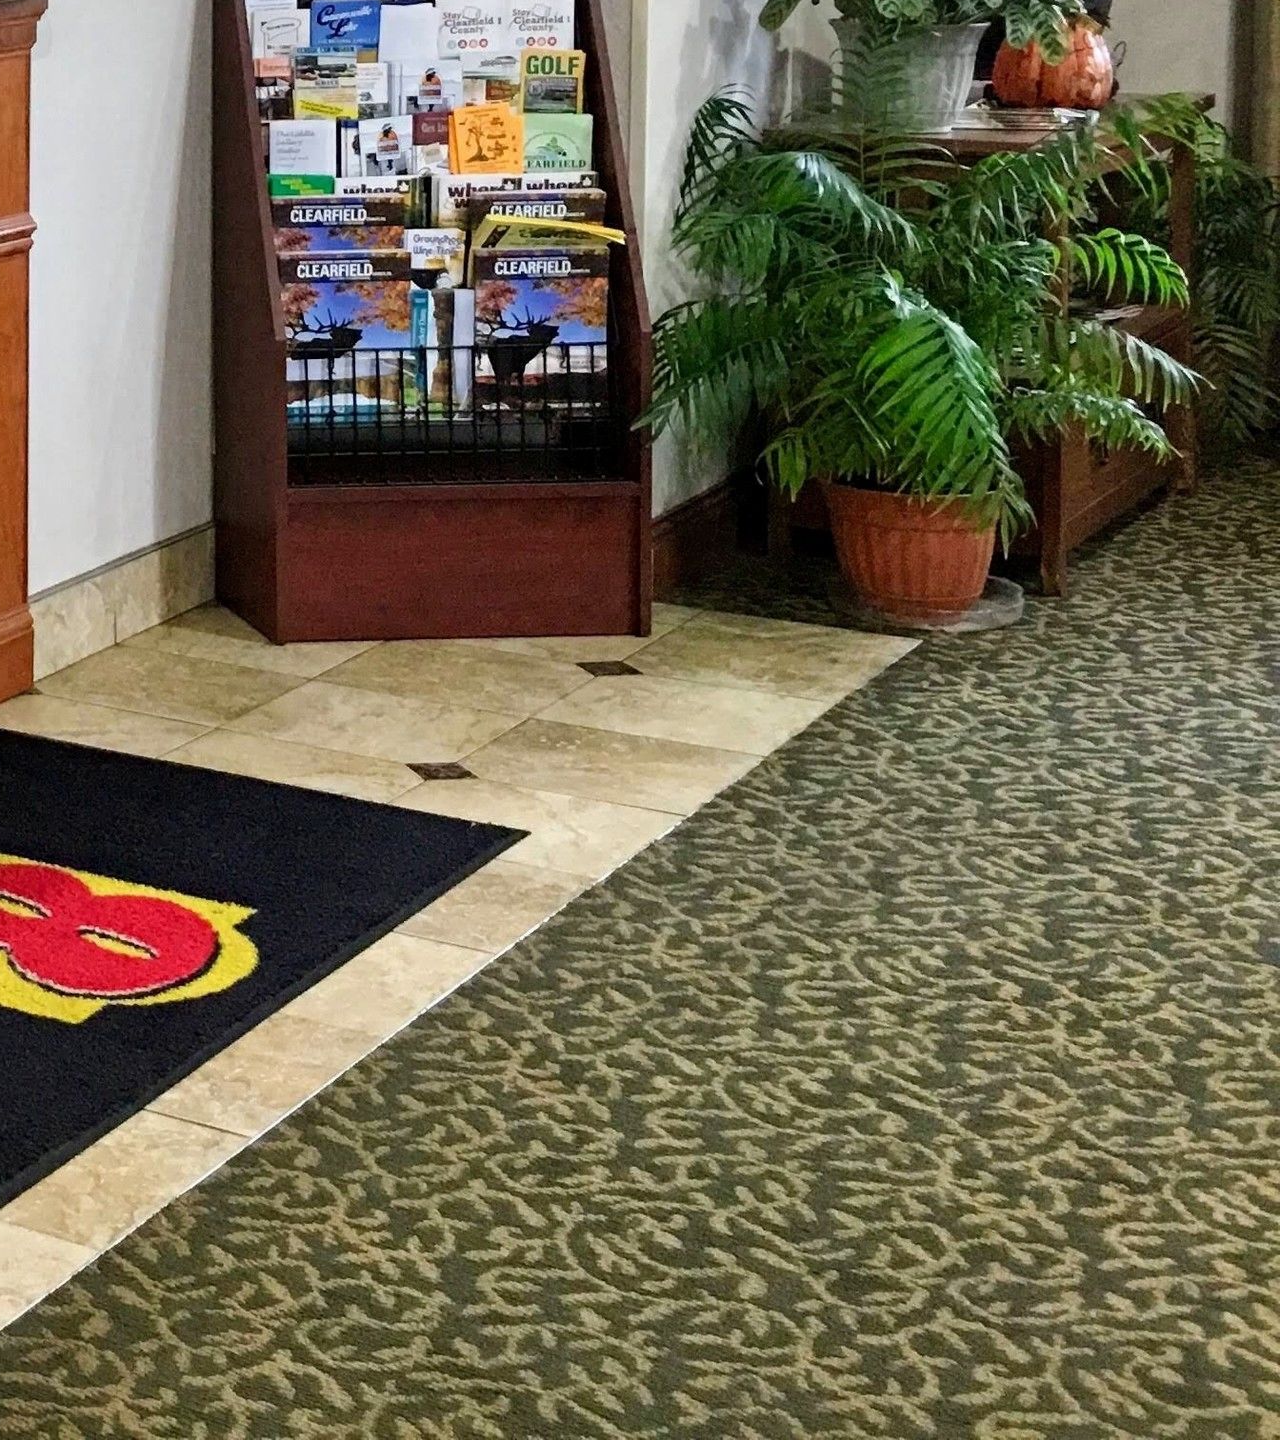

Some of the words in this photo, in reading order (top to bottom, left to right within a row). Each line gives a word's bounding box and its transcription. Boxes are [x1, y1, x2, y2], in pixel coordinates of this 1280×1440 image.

[444, 17, 494, 27] Clearfield
[514, 16, 563, 24] Clearfield
[526, 55, 580, 75] GOLF
[290, 209, 367, 223] CLEARFIELD
[490, 204, 567, 218] CLEARFIELD
[297, 263, 373, 279] CLEARFIELD
[494, 260, 571, 275] CLEARFIELD
